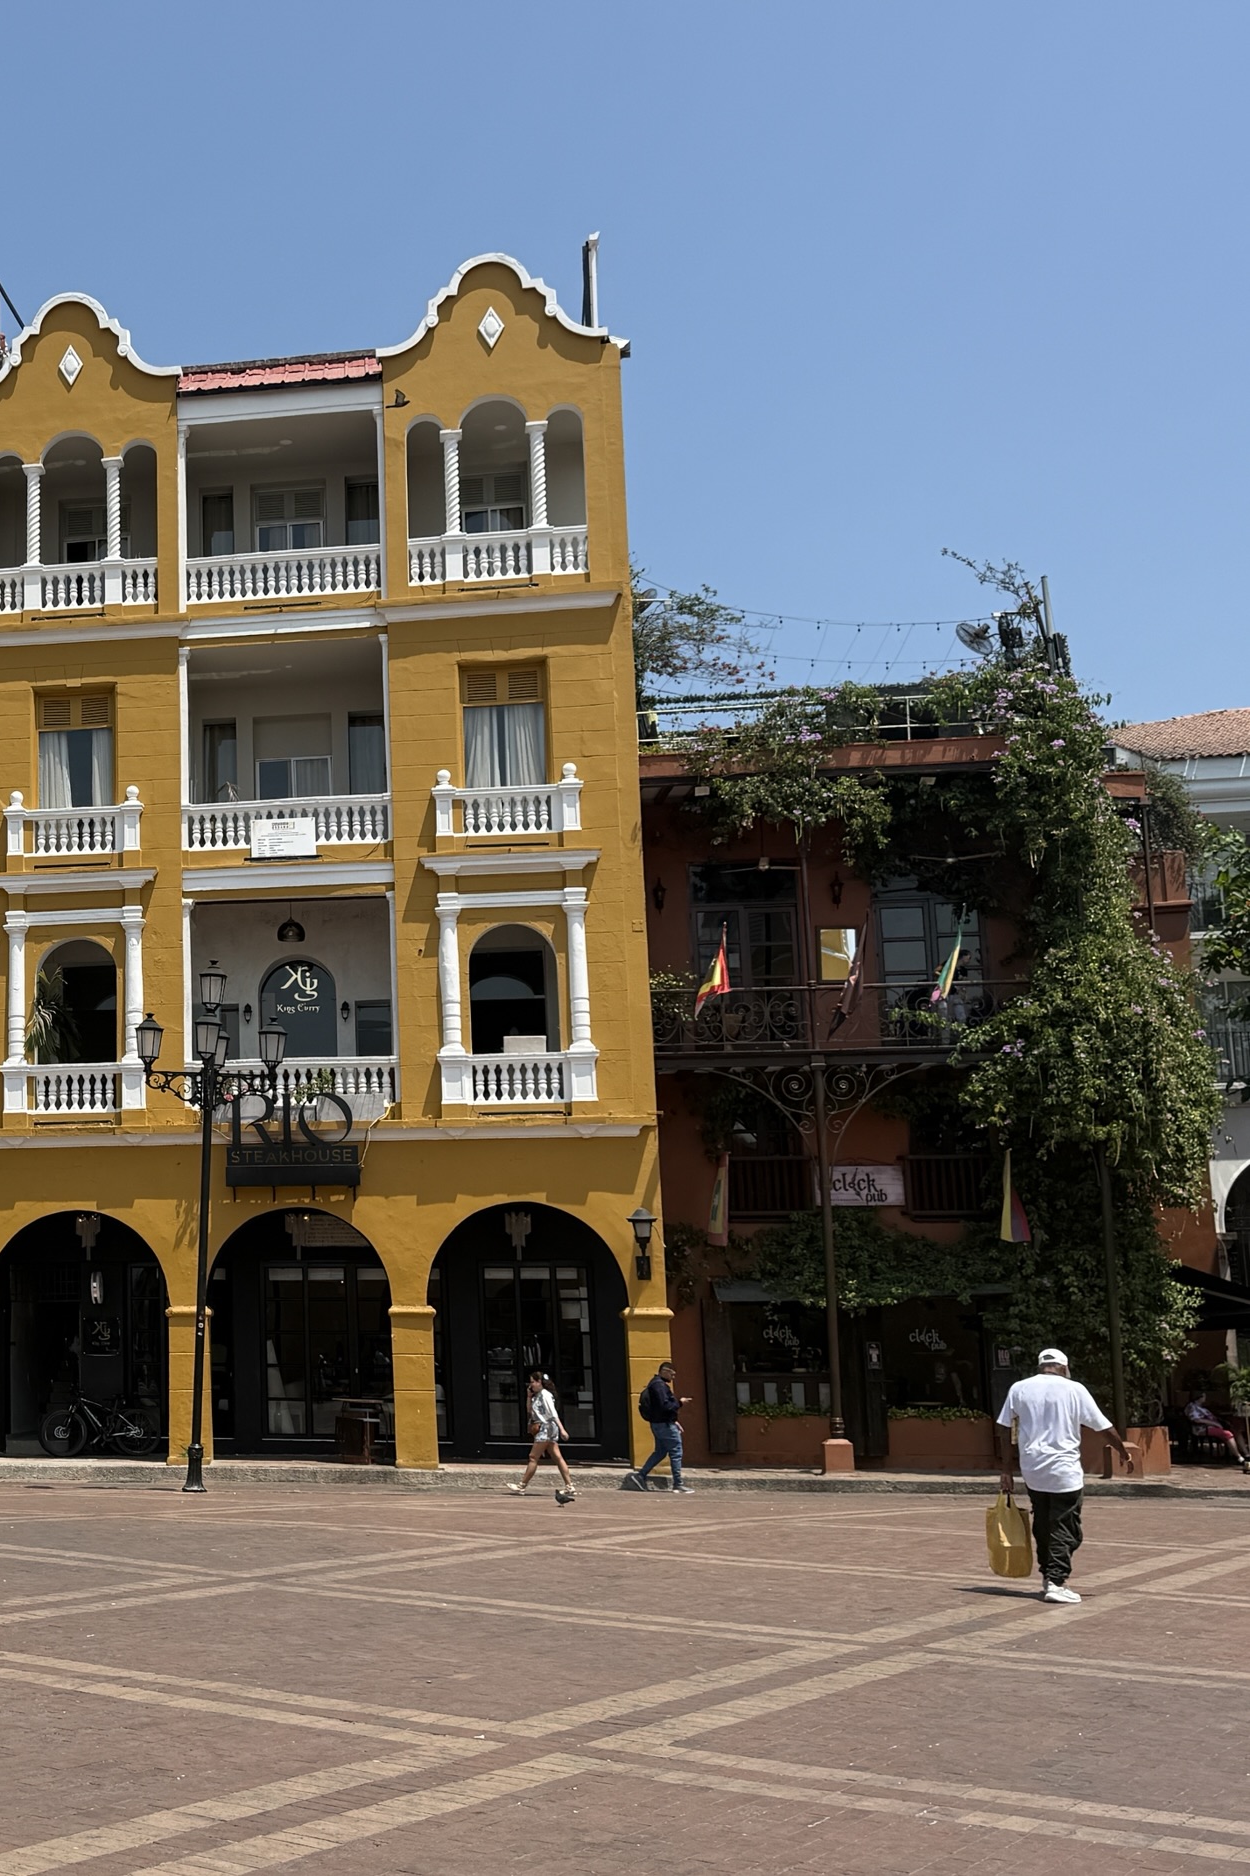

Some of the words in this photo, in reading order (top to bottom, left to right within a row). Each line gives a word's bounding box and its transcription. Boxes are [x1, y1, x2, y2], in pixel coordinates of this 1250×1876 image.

[297, 1003, 320, 1013] Curry
[231, 1092, 353, 1147] RIO
[231, 1148, 353, 1163] STEAKHOUSE
[832, 1169, 879, 1195] clock
[865, 1189, 888, 1206] pub
